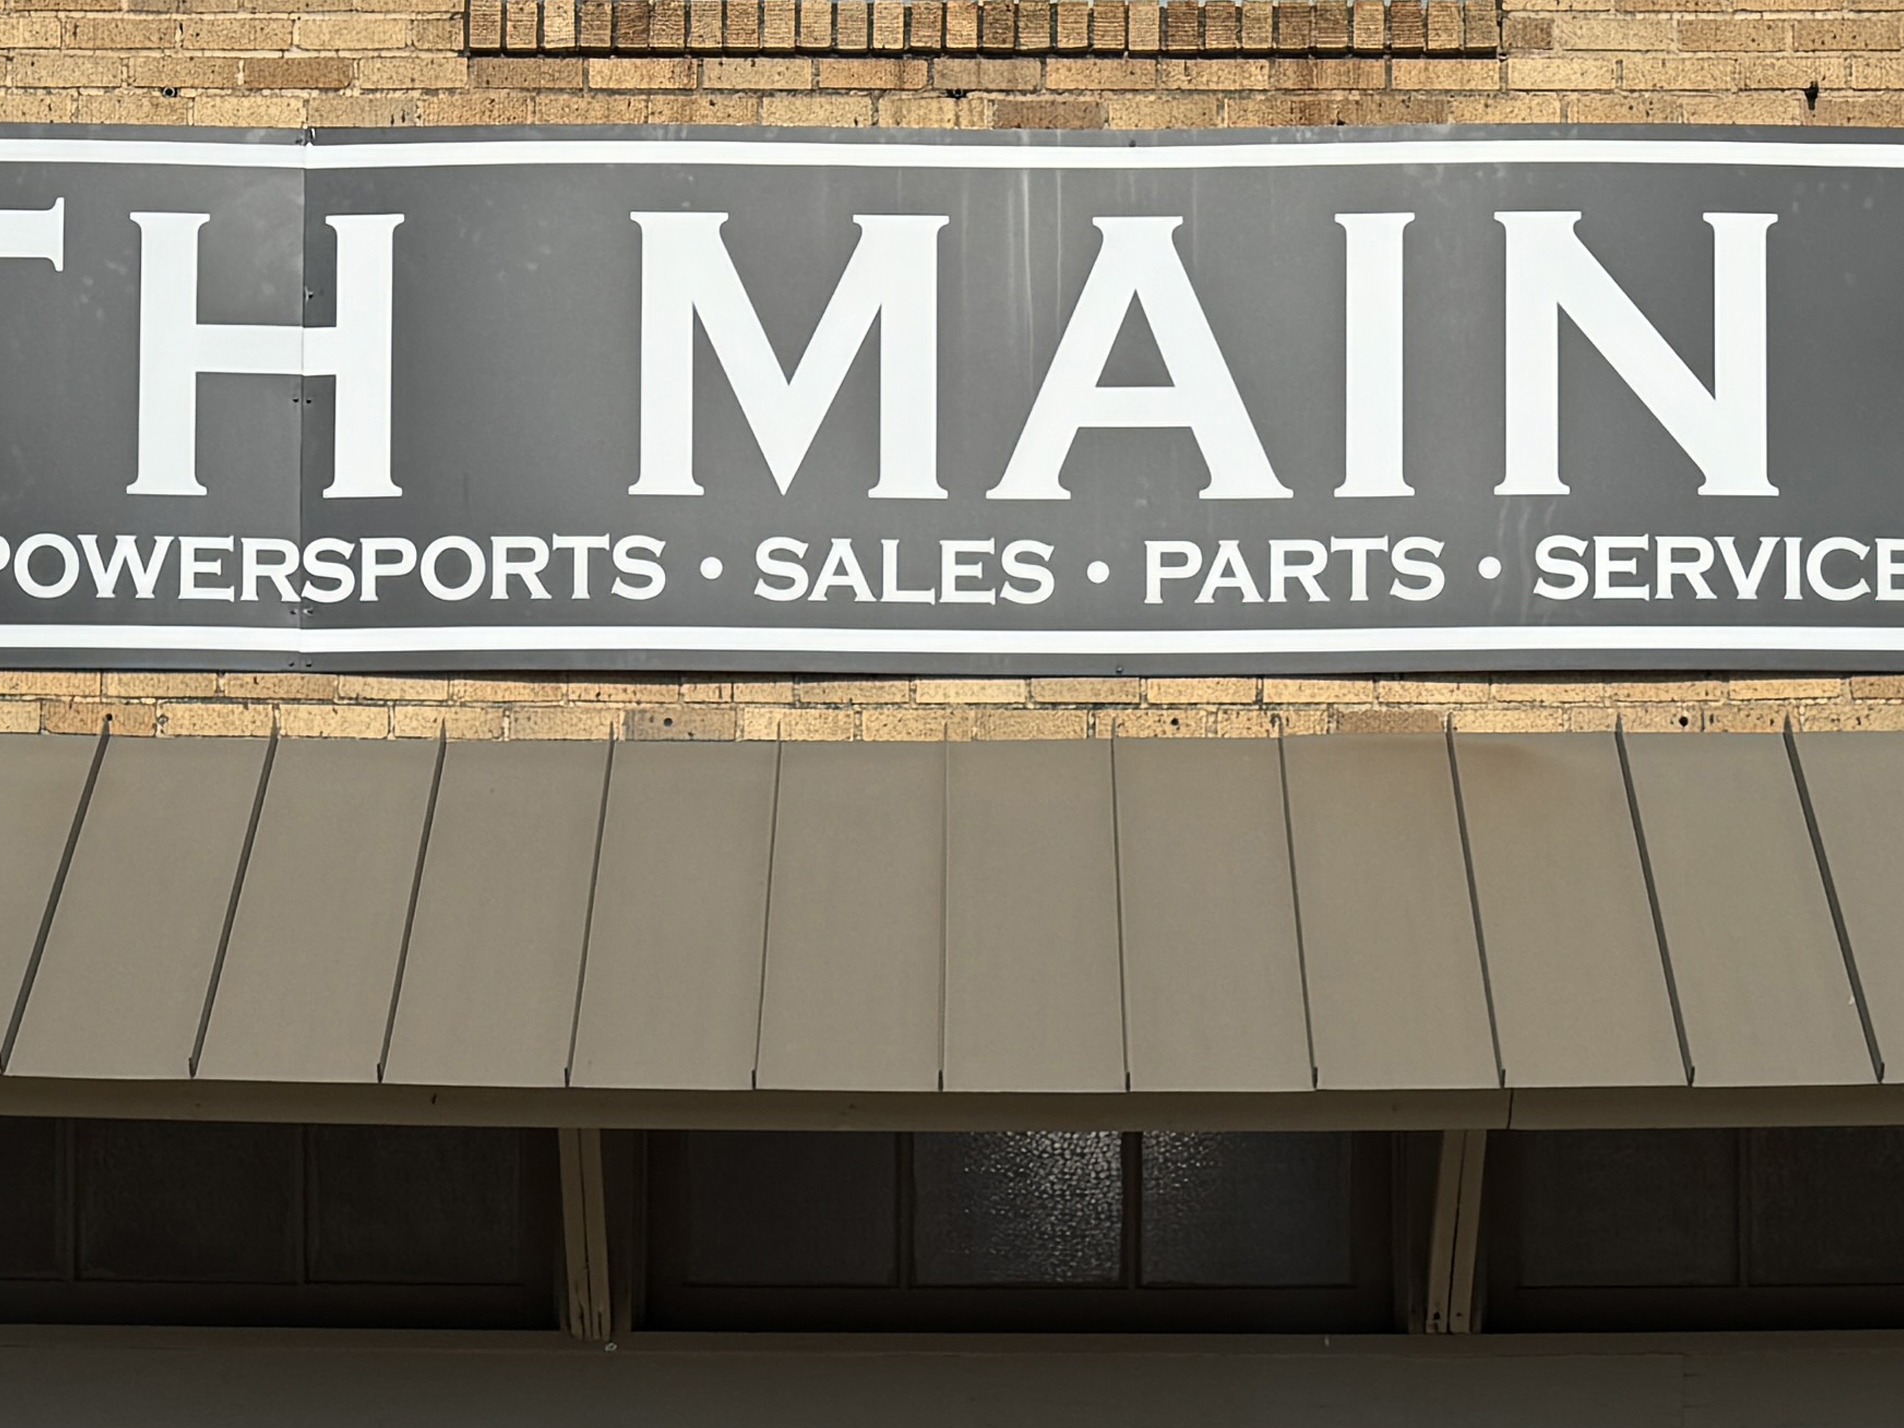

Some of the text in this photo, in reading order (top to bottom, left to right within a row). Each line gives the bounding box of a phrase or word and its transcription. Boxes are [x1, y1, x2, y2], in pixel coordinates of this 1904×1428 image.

[627, 210, 1780, 500] MAIN
[753, 536, 1056, 606] SALES
[1143, 534, 1446, 605] PARTS
